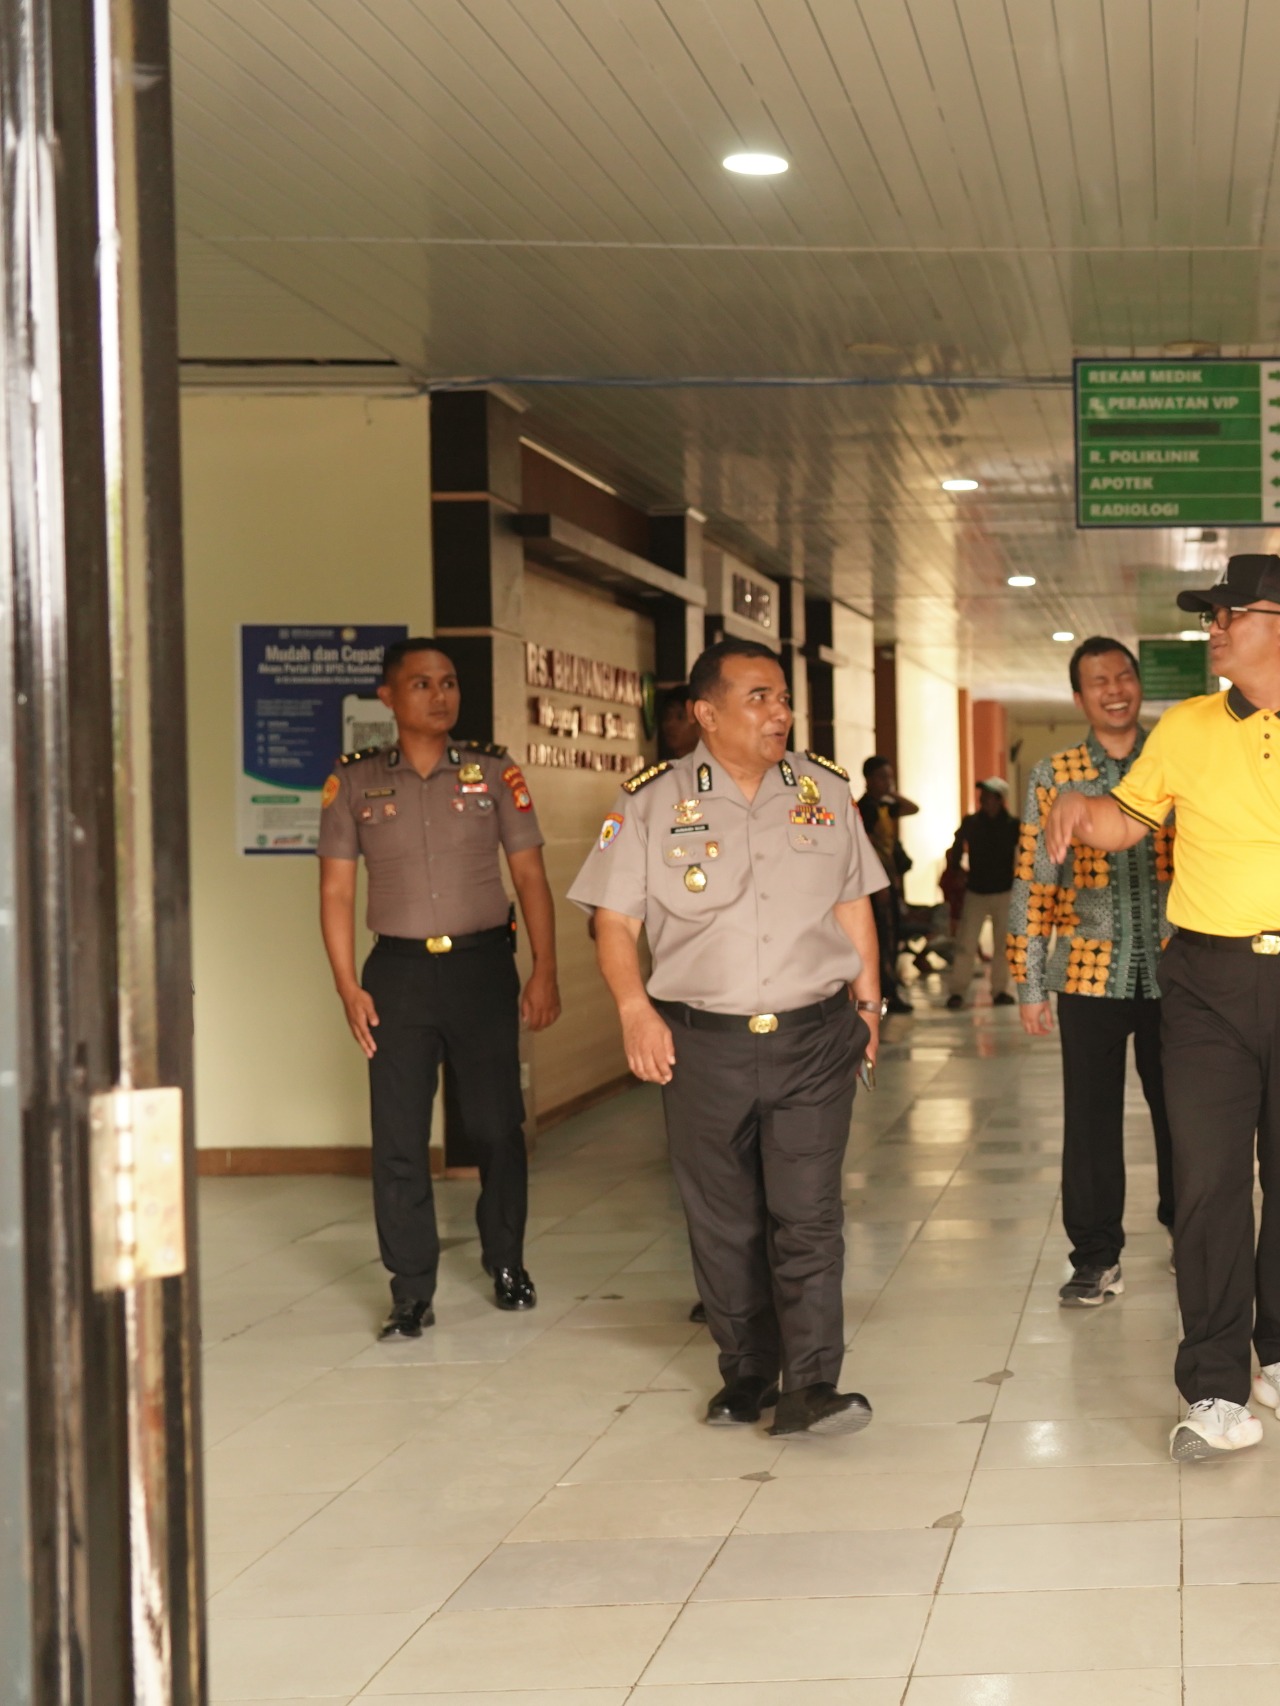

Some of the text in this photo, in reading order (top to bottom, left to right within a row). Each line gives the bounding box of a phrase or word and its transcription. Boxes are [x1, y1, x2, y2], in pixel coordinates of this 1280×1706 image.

[1087, 369, 1203, 383] REKAM MEDIK
[1108, 396, 1209, 410] PERAWATAN
[1211, 396, 1240, 409] VIP
[1089, 449, 1200, 464] R. POLIKLINIK
[1089, 477, 1154, 490] APOTEK
[1089, 503, 1180, 517] RADIOLOGI
